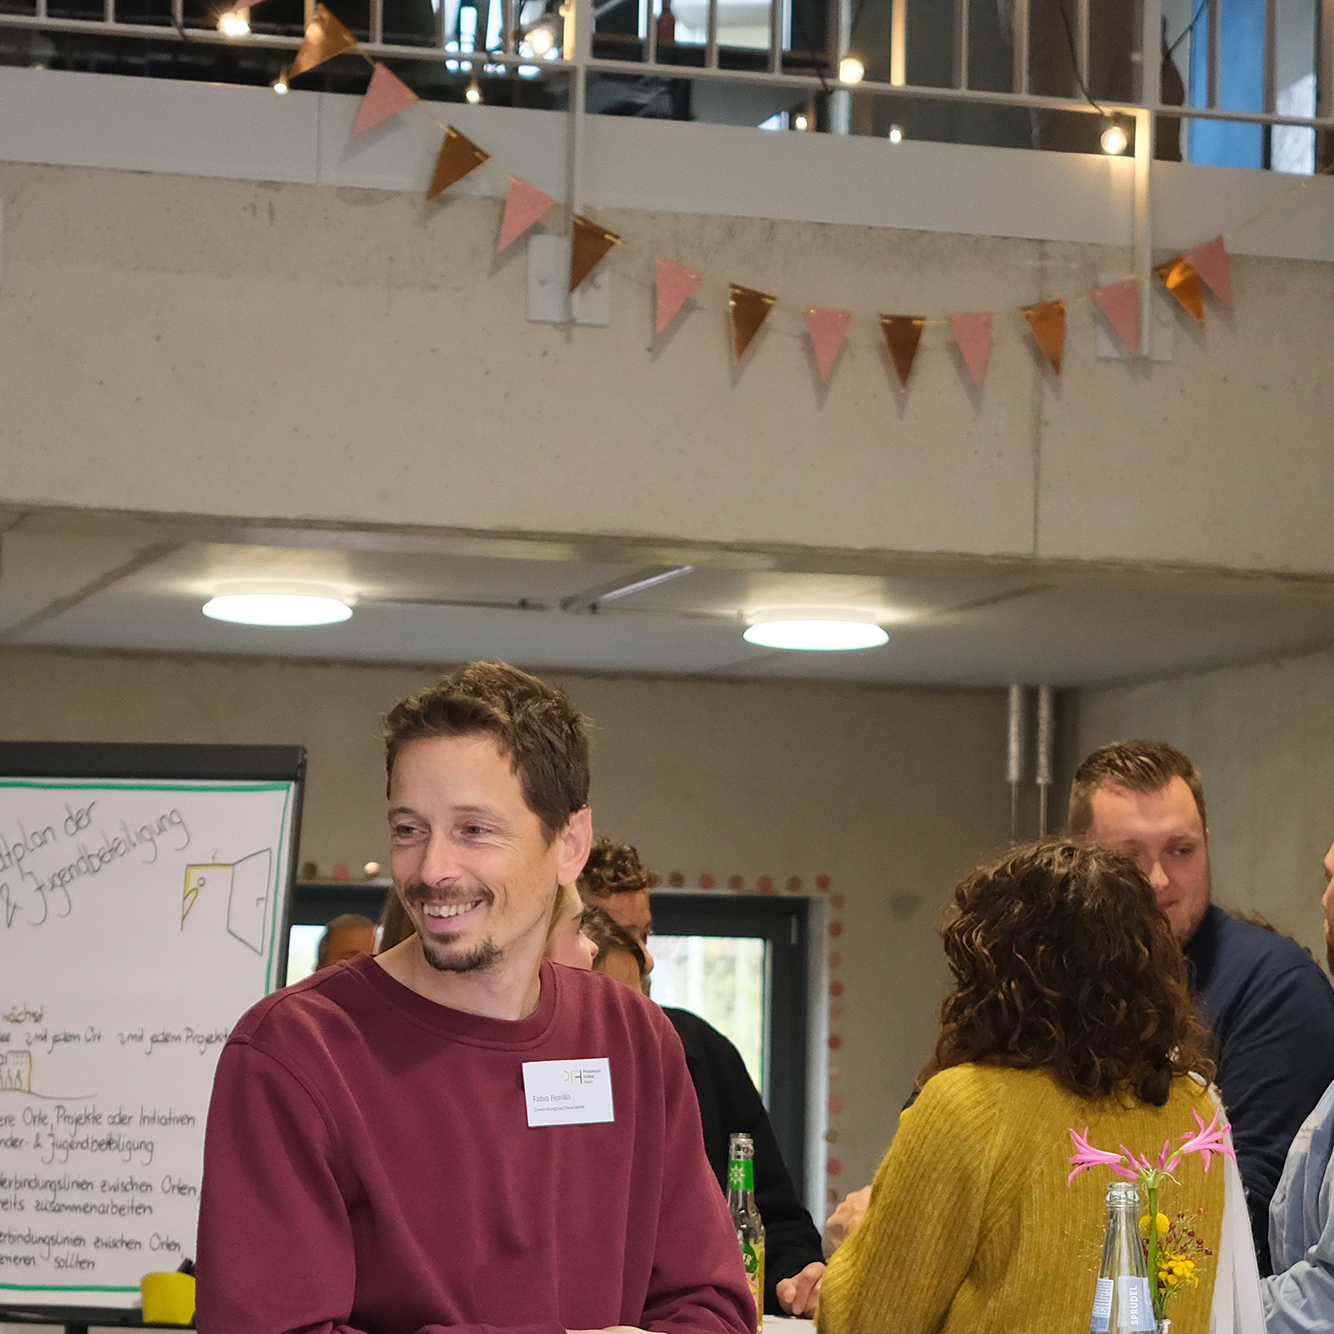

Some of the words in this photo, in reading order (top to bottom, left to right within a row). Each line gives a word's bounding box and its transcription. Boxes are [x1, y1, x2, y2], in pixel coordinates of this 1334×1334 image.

[63, 801, 97, 837] der
[23, 808, 190, 926] Jugendbeteiligung
[84, 1025, 102, 1043] Ort
[127, 1026, 144, 1042] mit
[54, 1104, 102, 1138] Projekte
[107, 1105, 134, 1125] oder
[139, 1104, 196, 1127] Initiativen
[41, 1131, 155, 1166] Jugendbeteiligung
[99, 1175, 153, 1193] zwischen
[34, 1197, 153, 1217] zusammenarbeiten
[93, 1232, 142, 1250] zwischen
[53, 1250, 96, 1271] sollten
[1130, 1285, 1139, 1326] SPRUDEL
